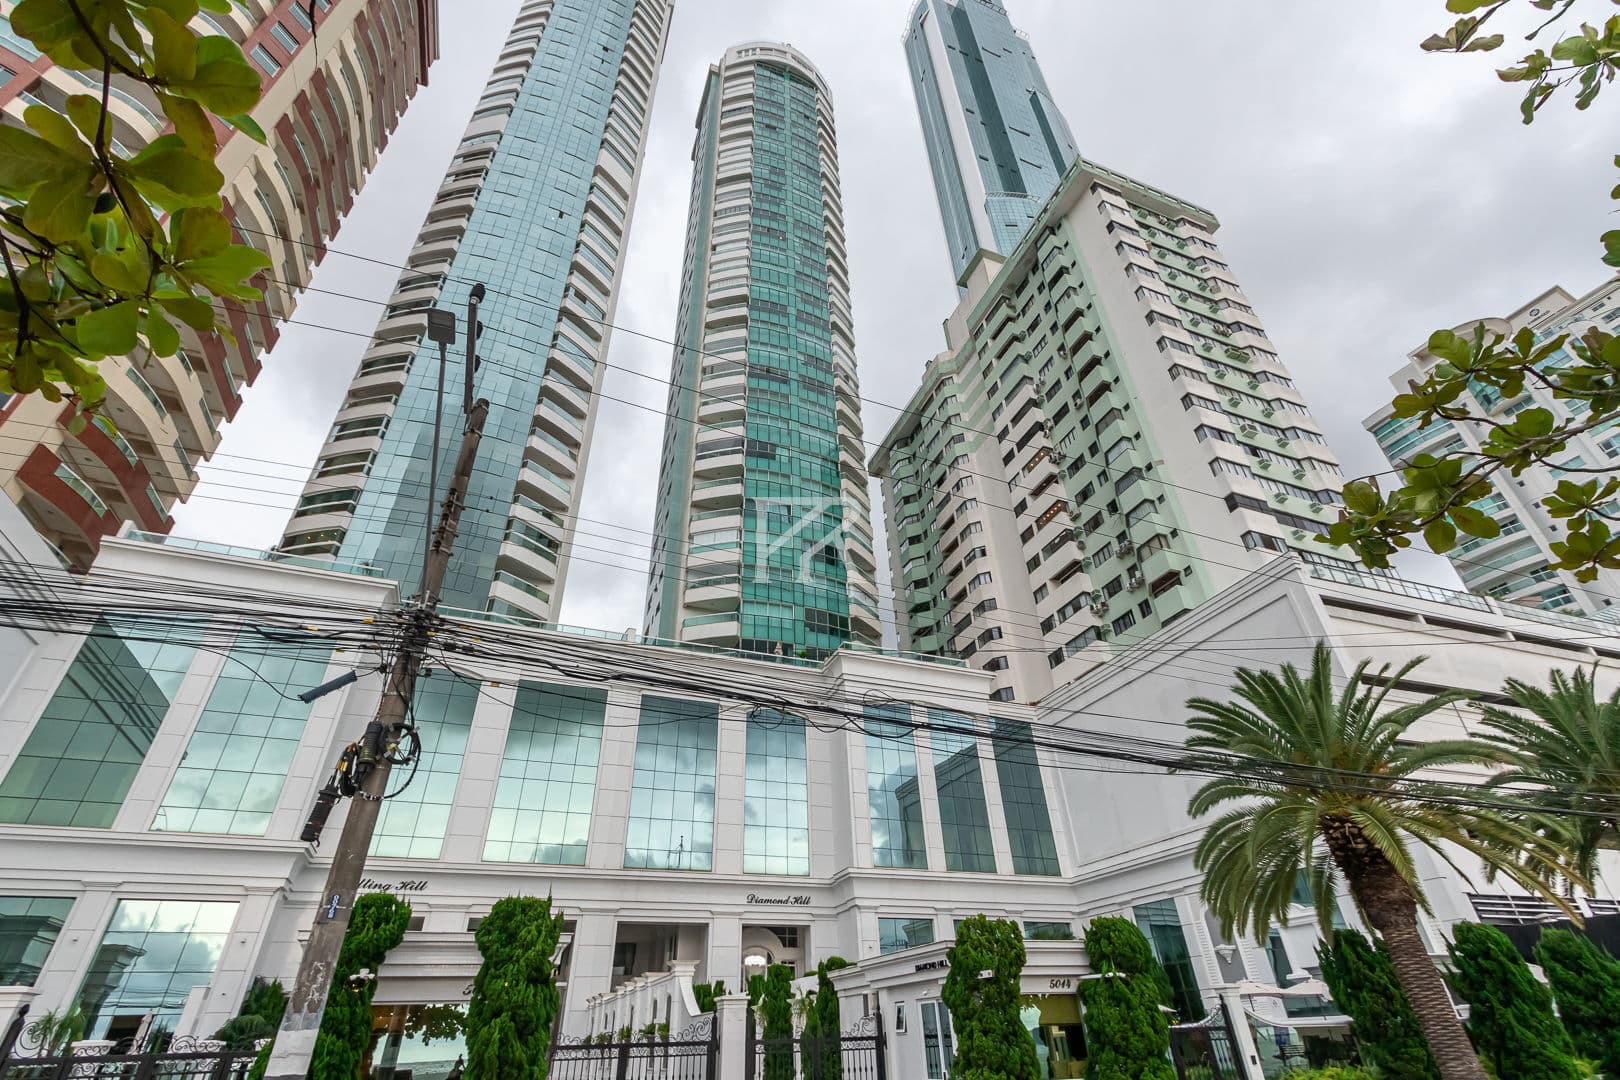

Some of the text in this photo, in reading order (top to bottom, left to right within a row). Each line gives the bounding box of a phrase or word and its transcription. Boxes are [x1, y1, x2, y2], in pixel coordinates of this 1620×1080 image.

[395, 880, 428, 891] Hill
[746, 893, 811, 905] Diamond Hill
[1049, 979, 1071, 989] 5014
